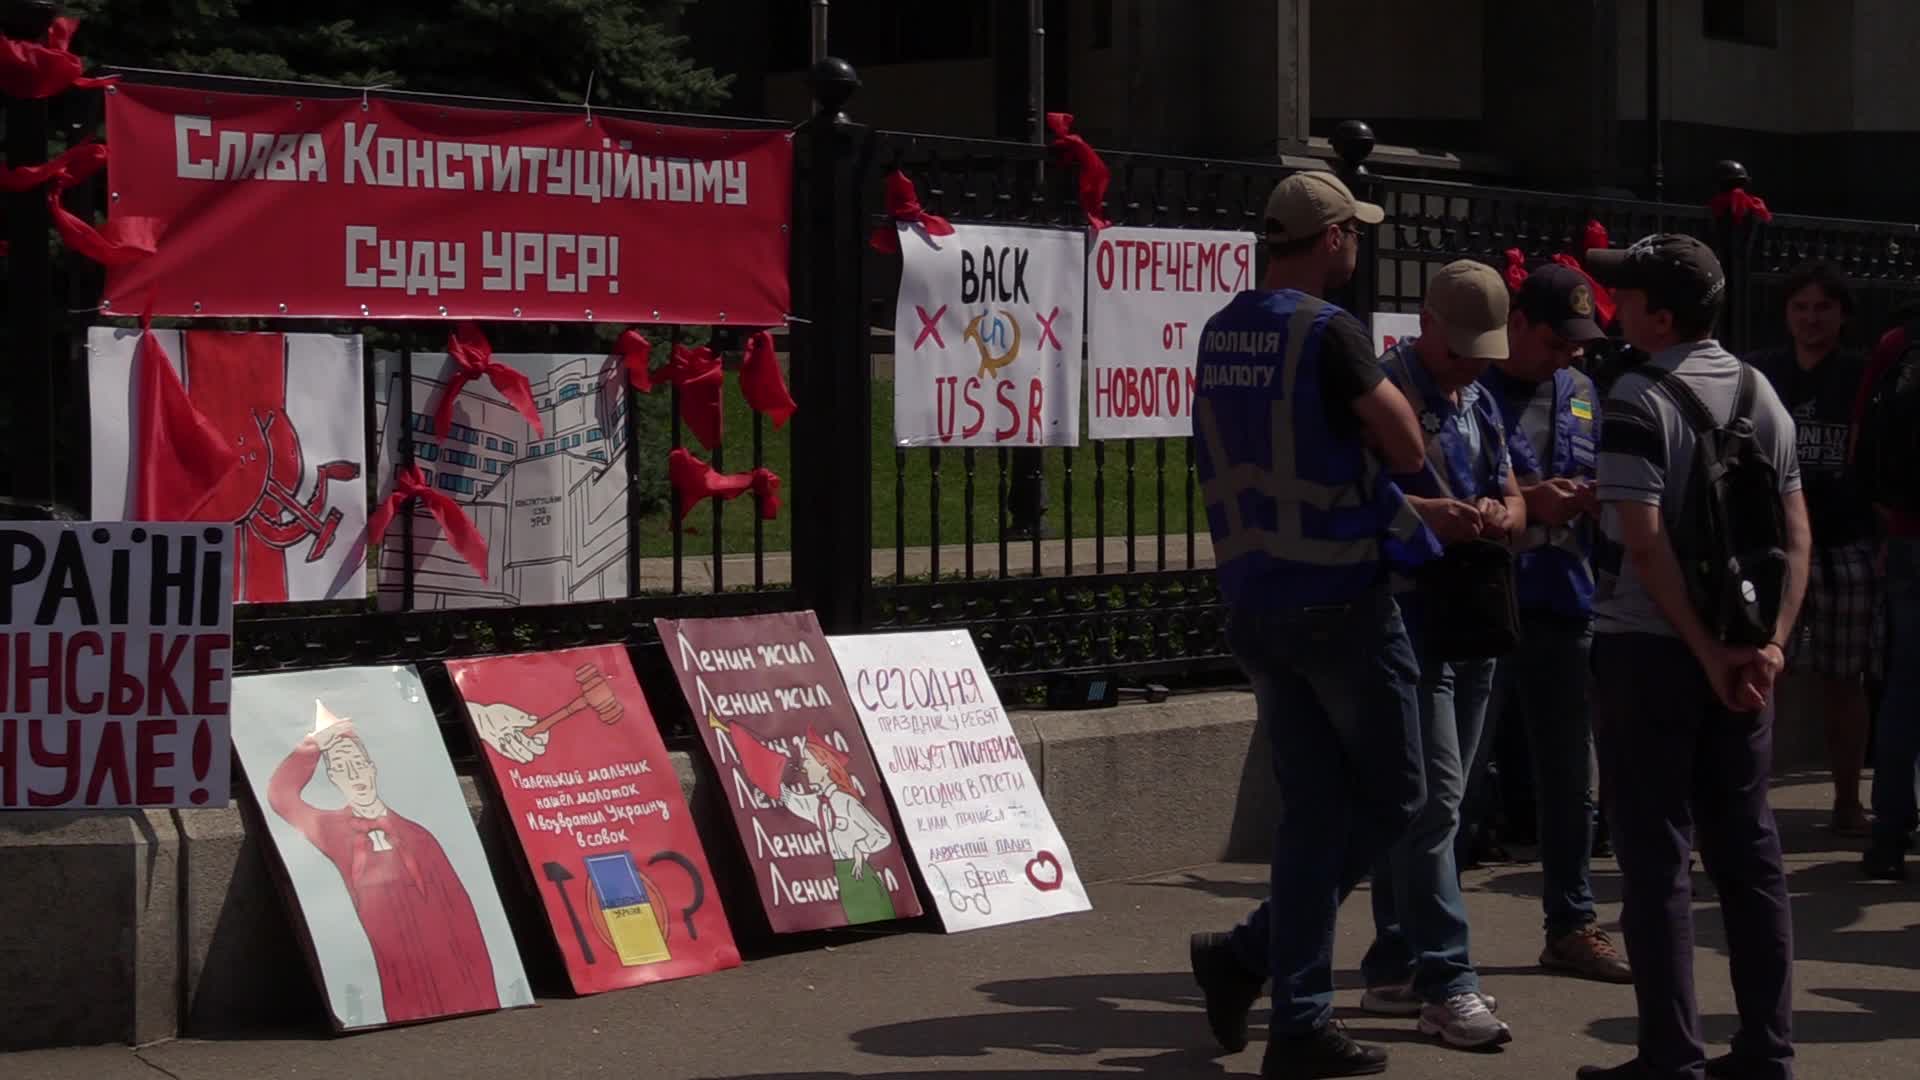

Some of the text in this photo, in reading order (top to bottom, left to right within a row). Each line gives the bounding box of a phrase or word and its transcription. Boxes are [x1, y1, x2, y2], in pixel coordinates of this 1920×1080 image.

[482, 231, 620, 294] УРСР!
[960, 246, 1030, 305] BACK
[1096, 240, 1250, 293] ОТРЕЧЕМСЯ
[1204, 331, 1280, 357] ПОЛІЦІЯ
[1096, 367, 1180, 418] НОВОГО
[1201, 364, 1276, 389] ДІАЛОГУ
[935, 376, 1045, 444] USSR
[677, 631, 815, 673] Ленин жил
[0, 631, 231, 716] НСЬКЕ
[696, 675, 832, 717] Ленин жил
[508, 760, 651, 789] Маленький мальчик
[576, 783, 640, 805] молоток
[604, 799, 670, 825] Украину
[586, 828, 629, 847] совок
[752, 815, 827, 859] Ленин
